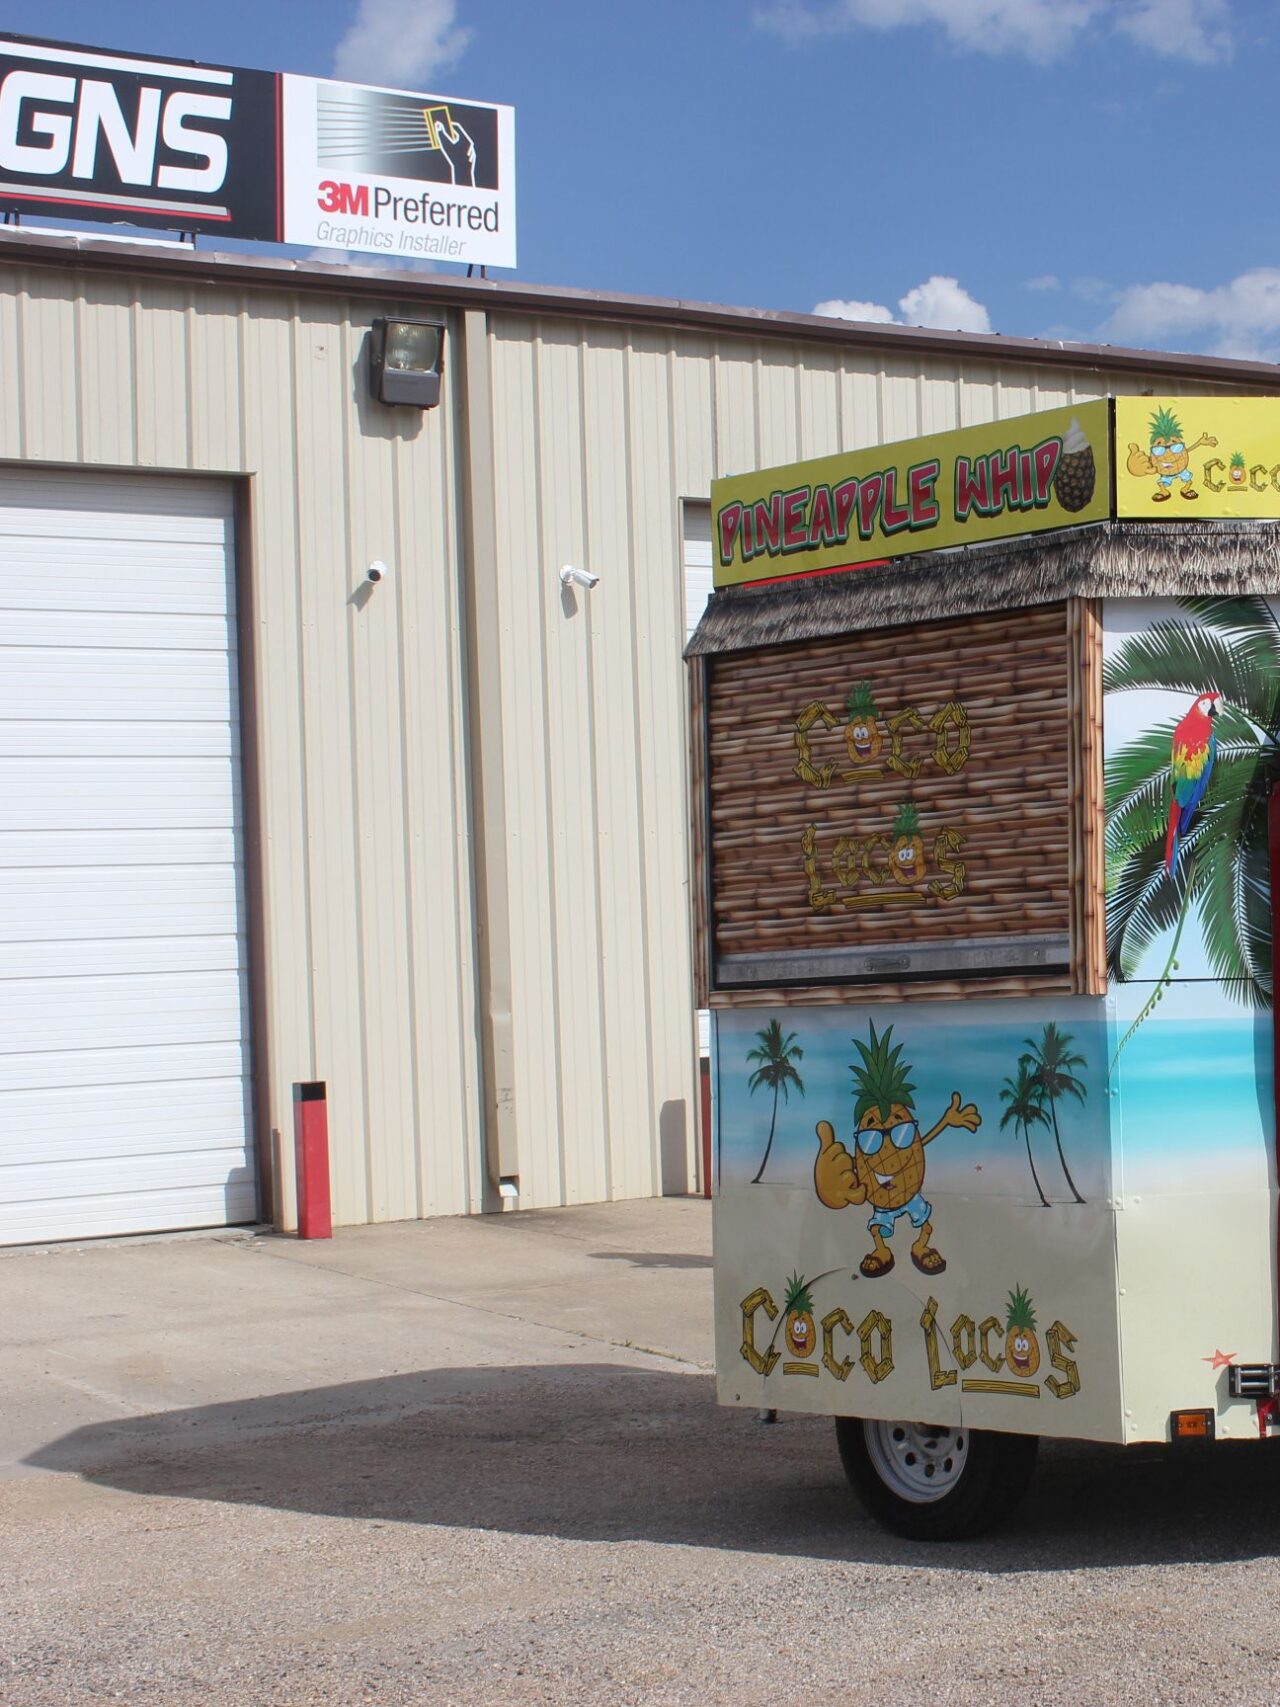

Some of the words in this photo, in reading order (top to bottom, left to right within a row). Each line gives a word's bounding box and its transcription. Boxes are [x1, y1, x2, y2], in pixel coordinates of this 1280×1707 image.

[0, 70, 233, 194] GNS
[316, 221, 394, 249] Graphics
[399, 230, 467, 256] Installer
[317, 180, 369, 217] 3M
[374, 187, 499, 233] Preferred
[718, 458, 940, 566] PINEAPPLE
[954, 436, 1064, 522] WHIP
